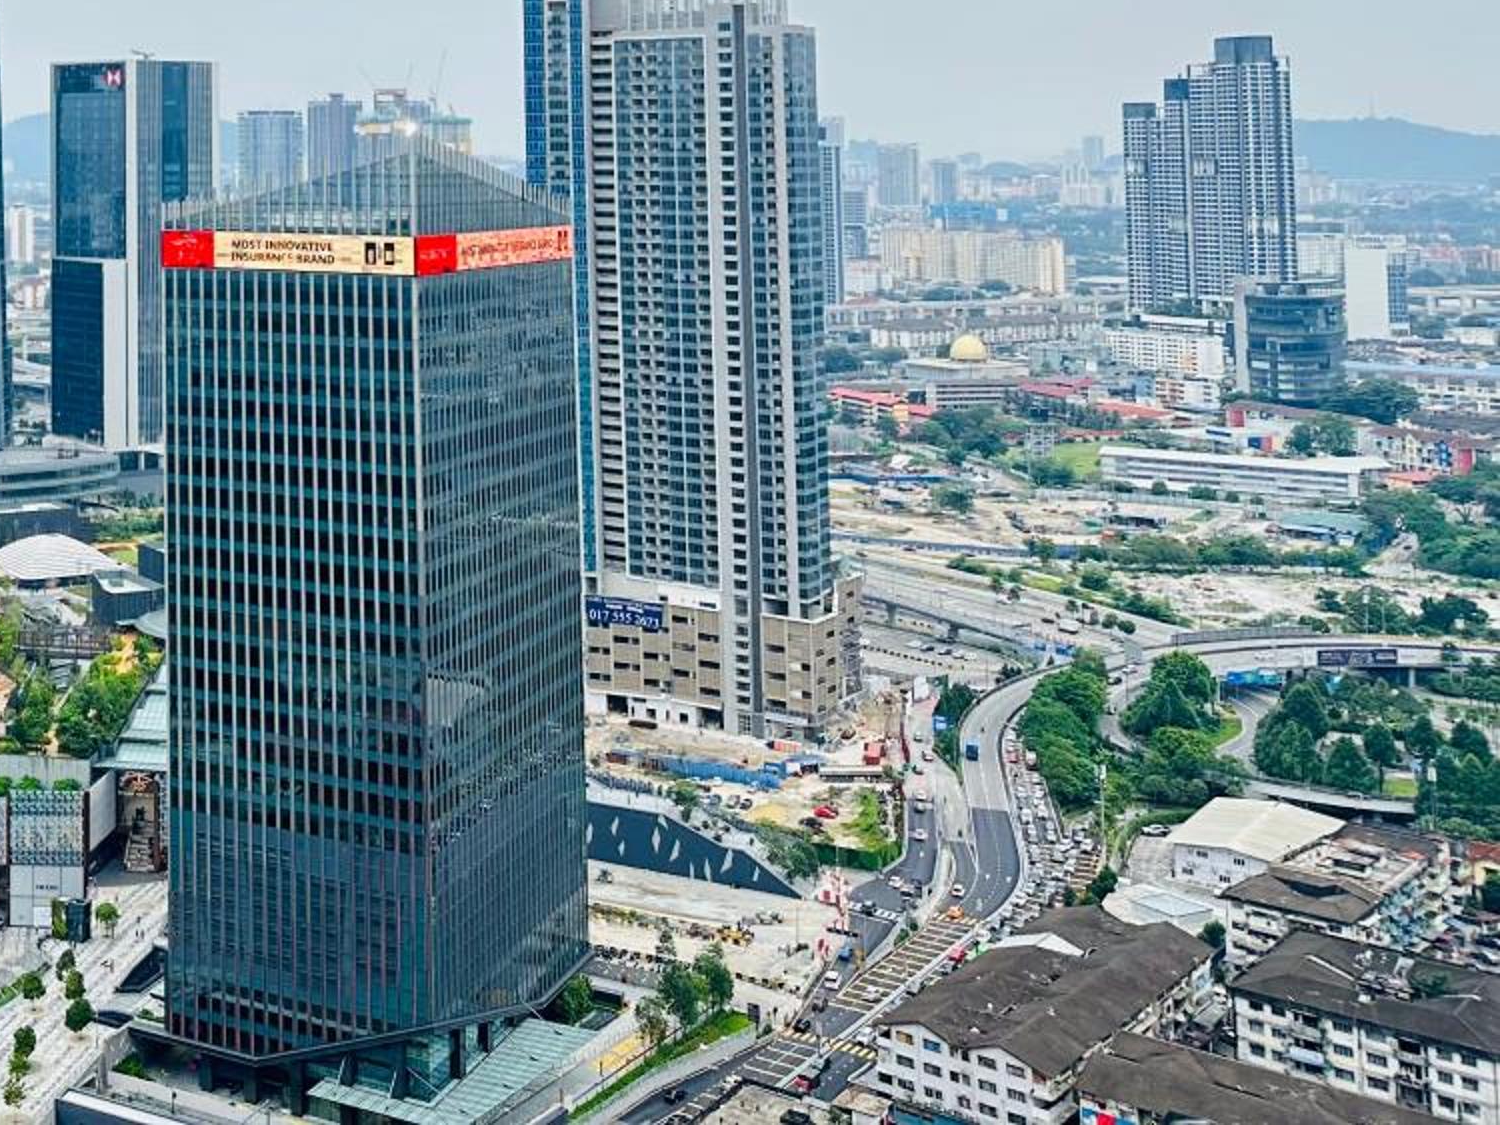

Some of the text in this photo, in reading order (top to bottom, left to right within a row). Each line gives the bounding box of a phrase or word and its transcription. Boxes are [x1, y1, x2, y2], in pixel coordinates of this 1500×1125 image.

[231, 239, 333, 252] MOST INNOVATIVE
[295, 254, 335, 265] BRAND
[589, 609, 609, 621] 017
